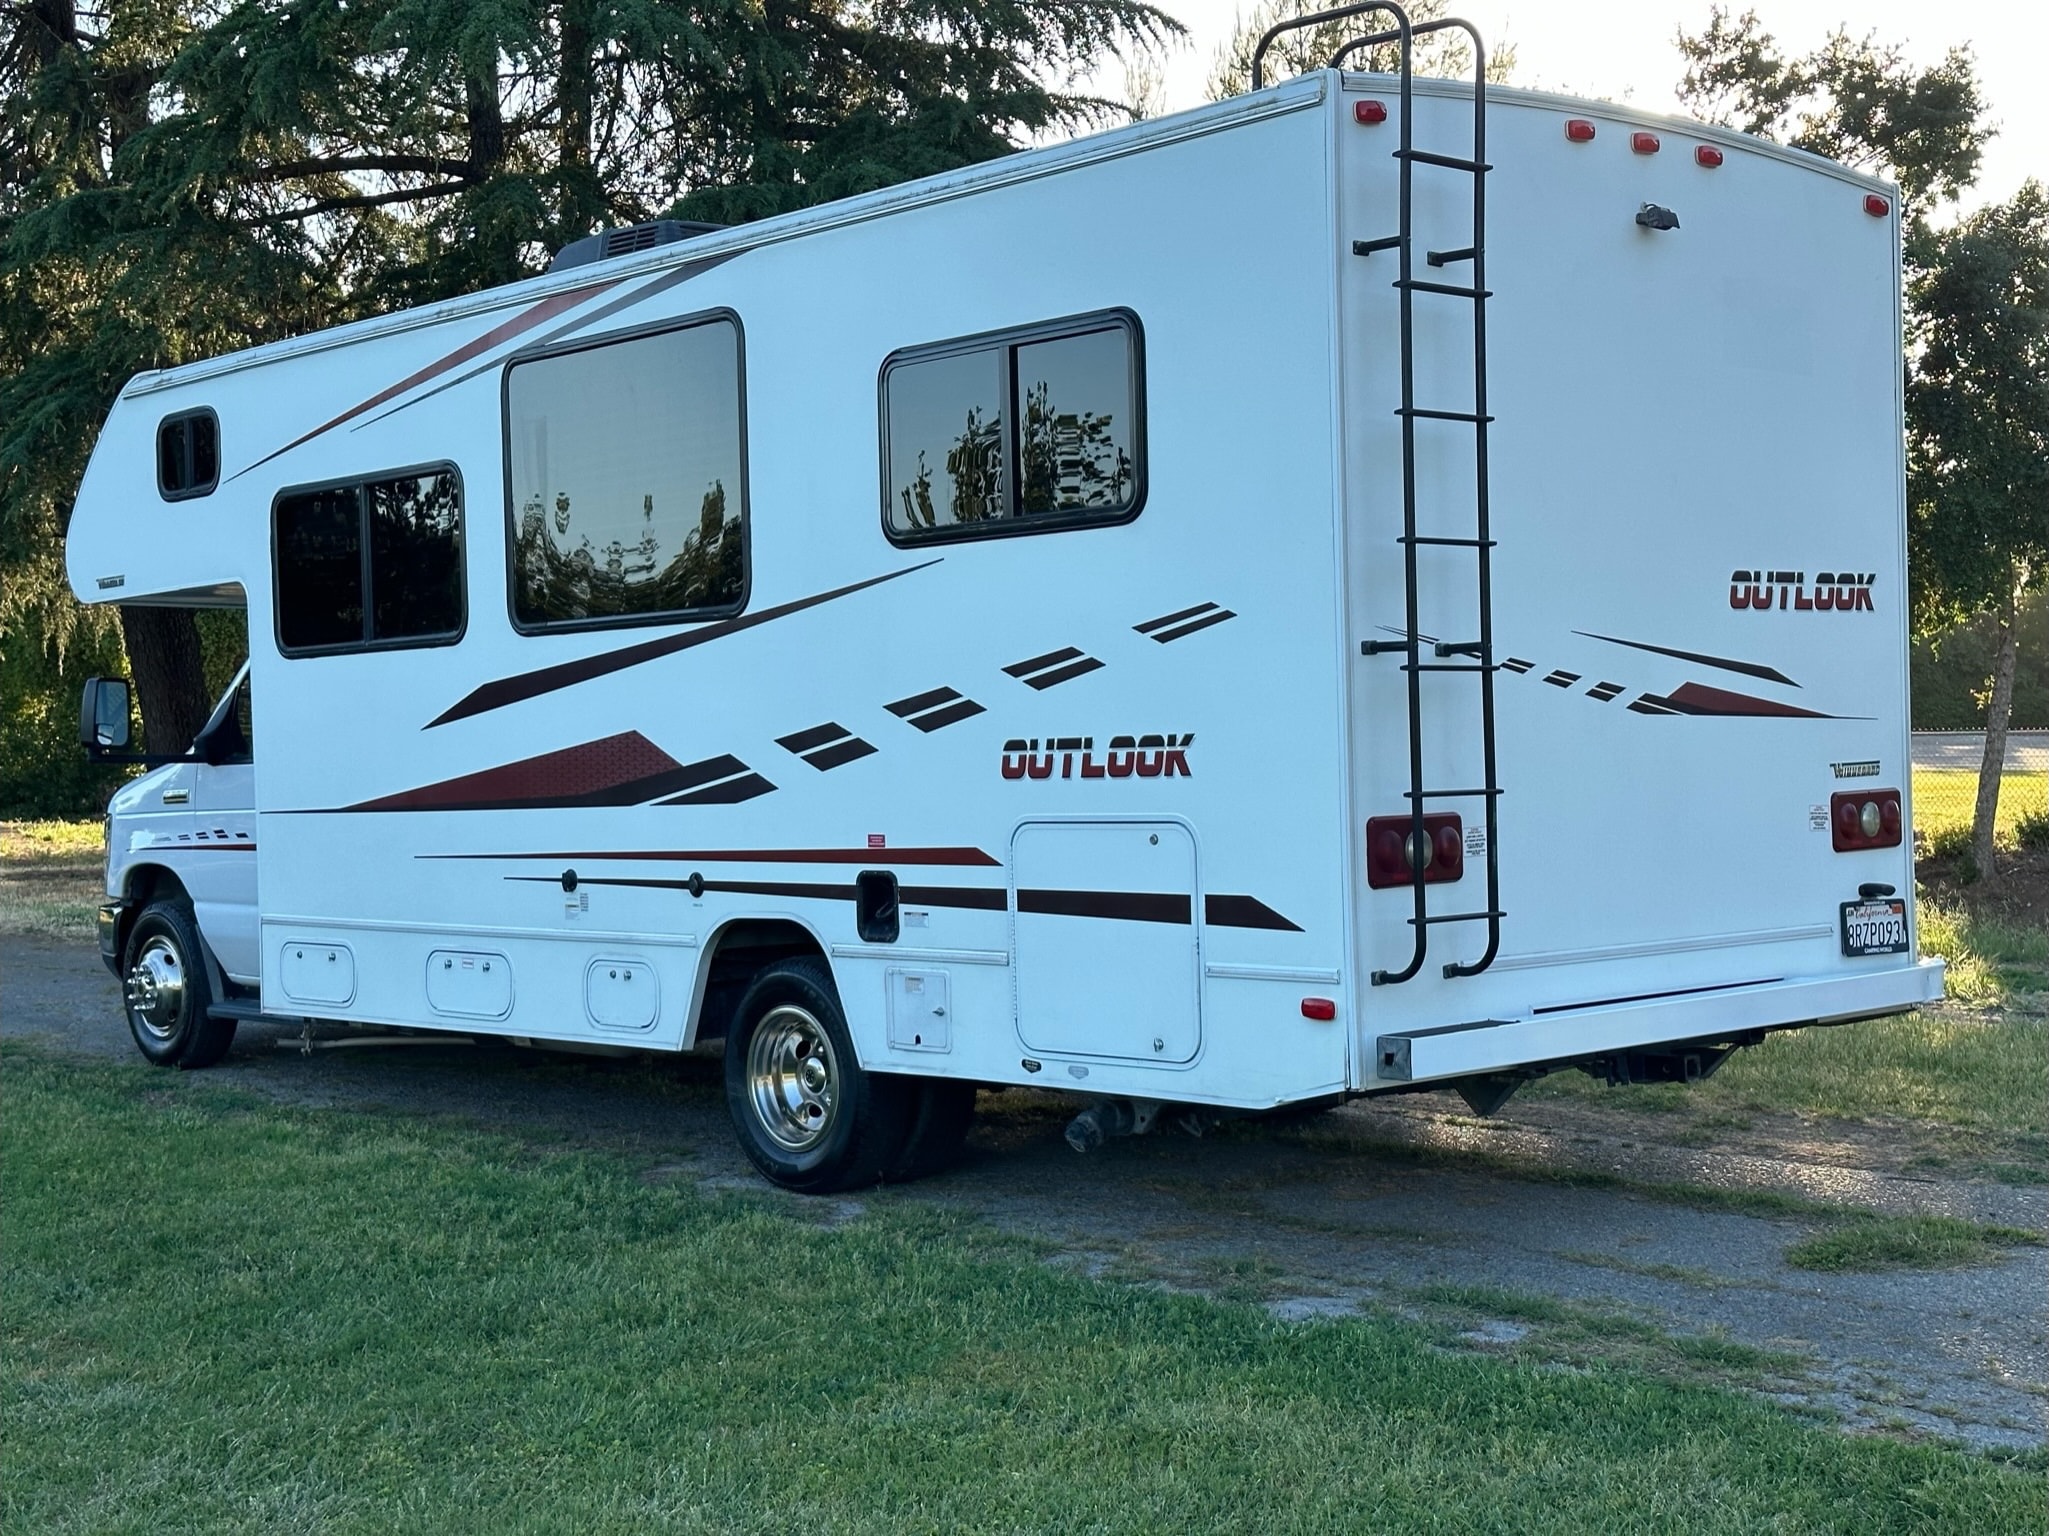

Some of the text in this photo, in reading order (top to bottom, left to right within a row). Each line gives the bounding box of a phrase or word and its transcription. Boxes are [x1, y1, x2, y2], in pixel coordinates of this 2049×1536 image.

[1730, 570, 1876, 611] OUTLOOK
[1001, 733, 1195, 779] OUTLOOK
[1848, 920, 1900, 948] 8RZP093
